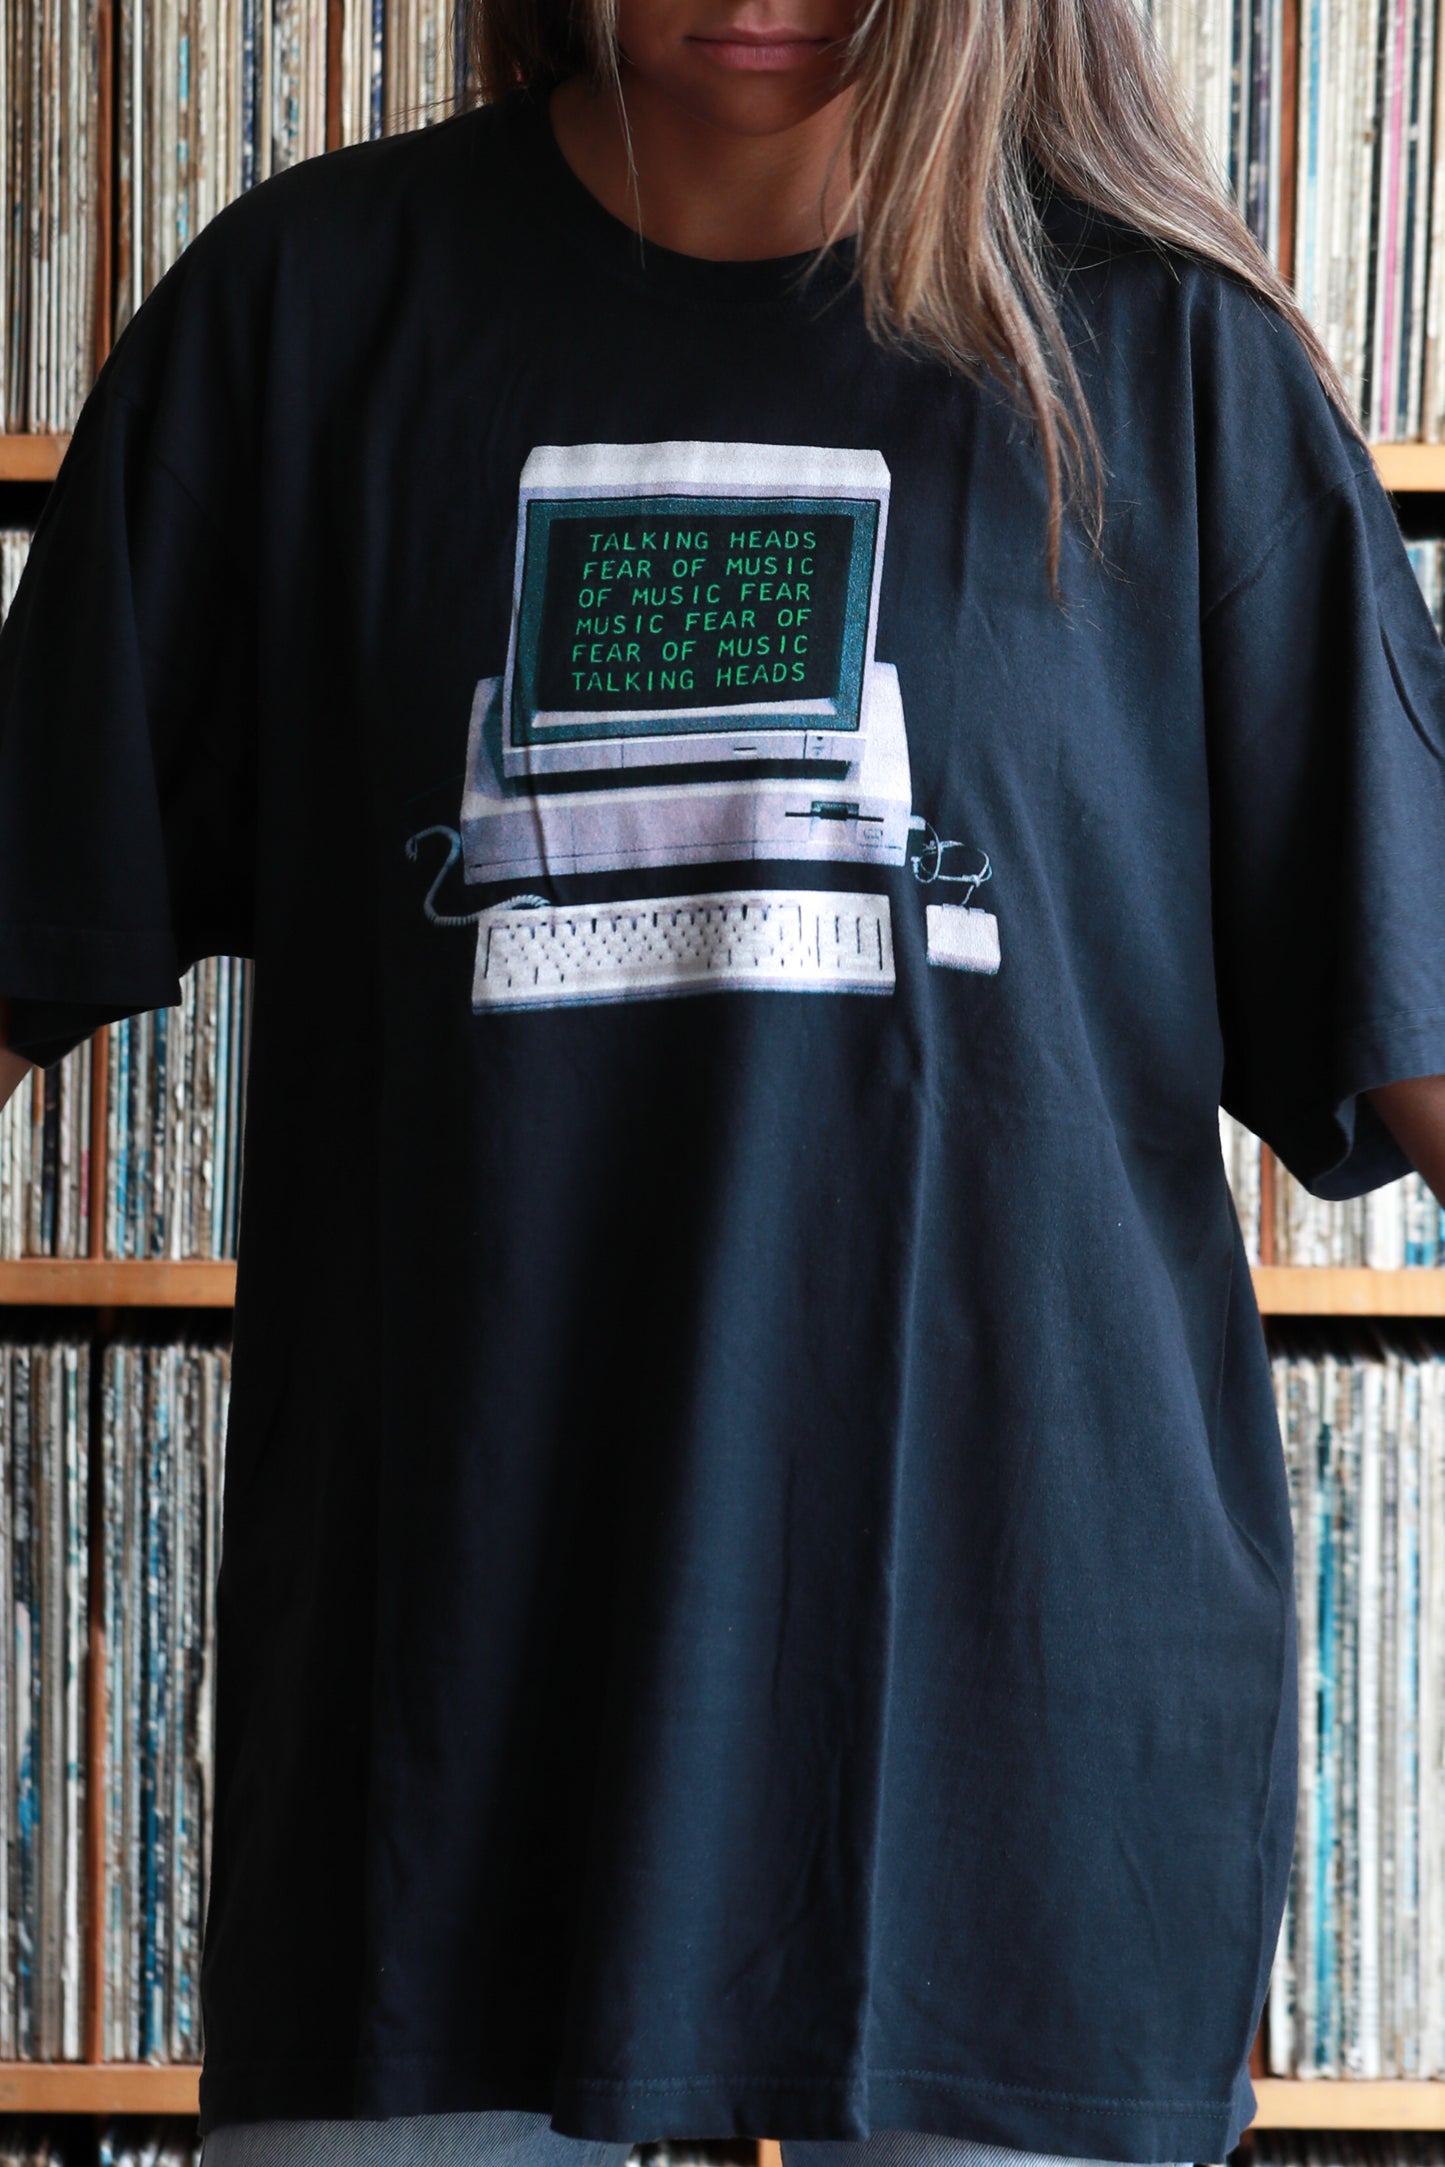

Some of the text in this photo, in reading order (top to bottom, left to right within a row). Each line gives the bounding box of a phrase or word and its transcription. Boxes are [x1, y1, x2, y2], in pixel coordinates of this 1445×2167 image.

[590, 530, 817, 552] TALKING HEADS
[583, 556, 814, 580] FEAR OF MUSIC
[578, 582, 810, 608] OF MUSIC FEAR
[576, 608, 812, 635] MUSIC FEAR OF
[572, 635, 808, 662] FEAR OF MUSIC
[572, 662, 805, 692] TALKING HEADS
